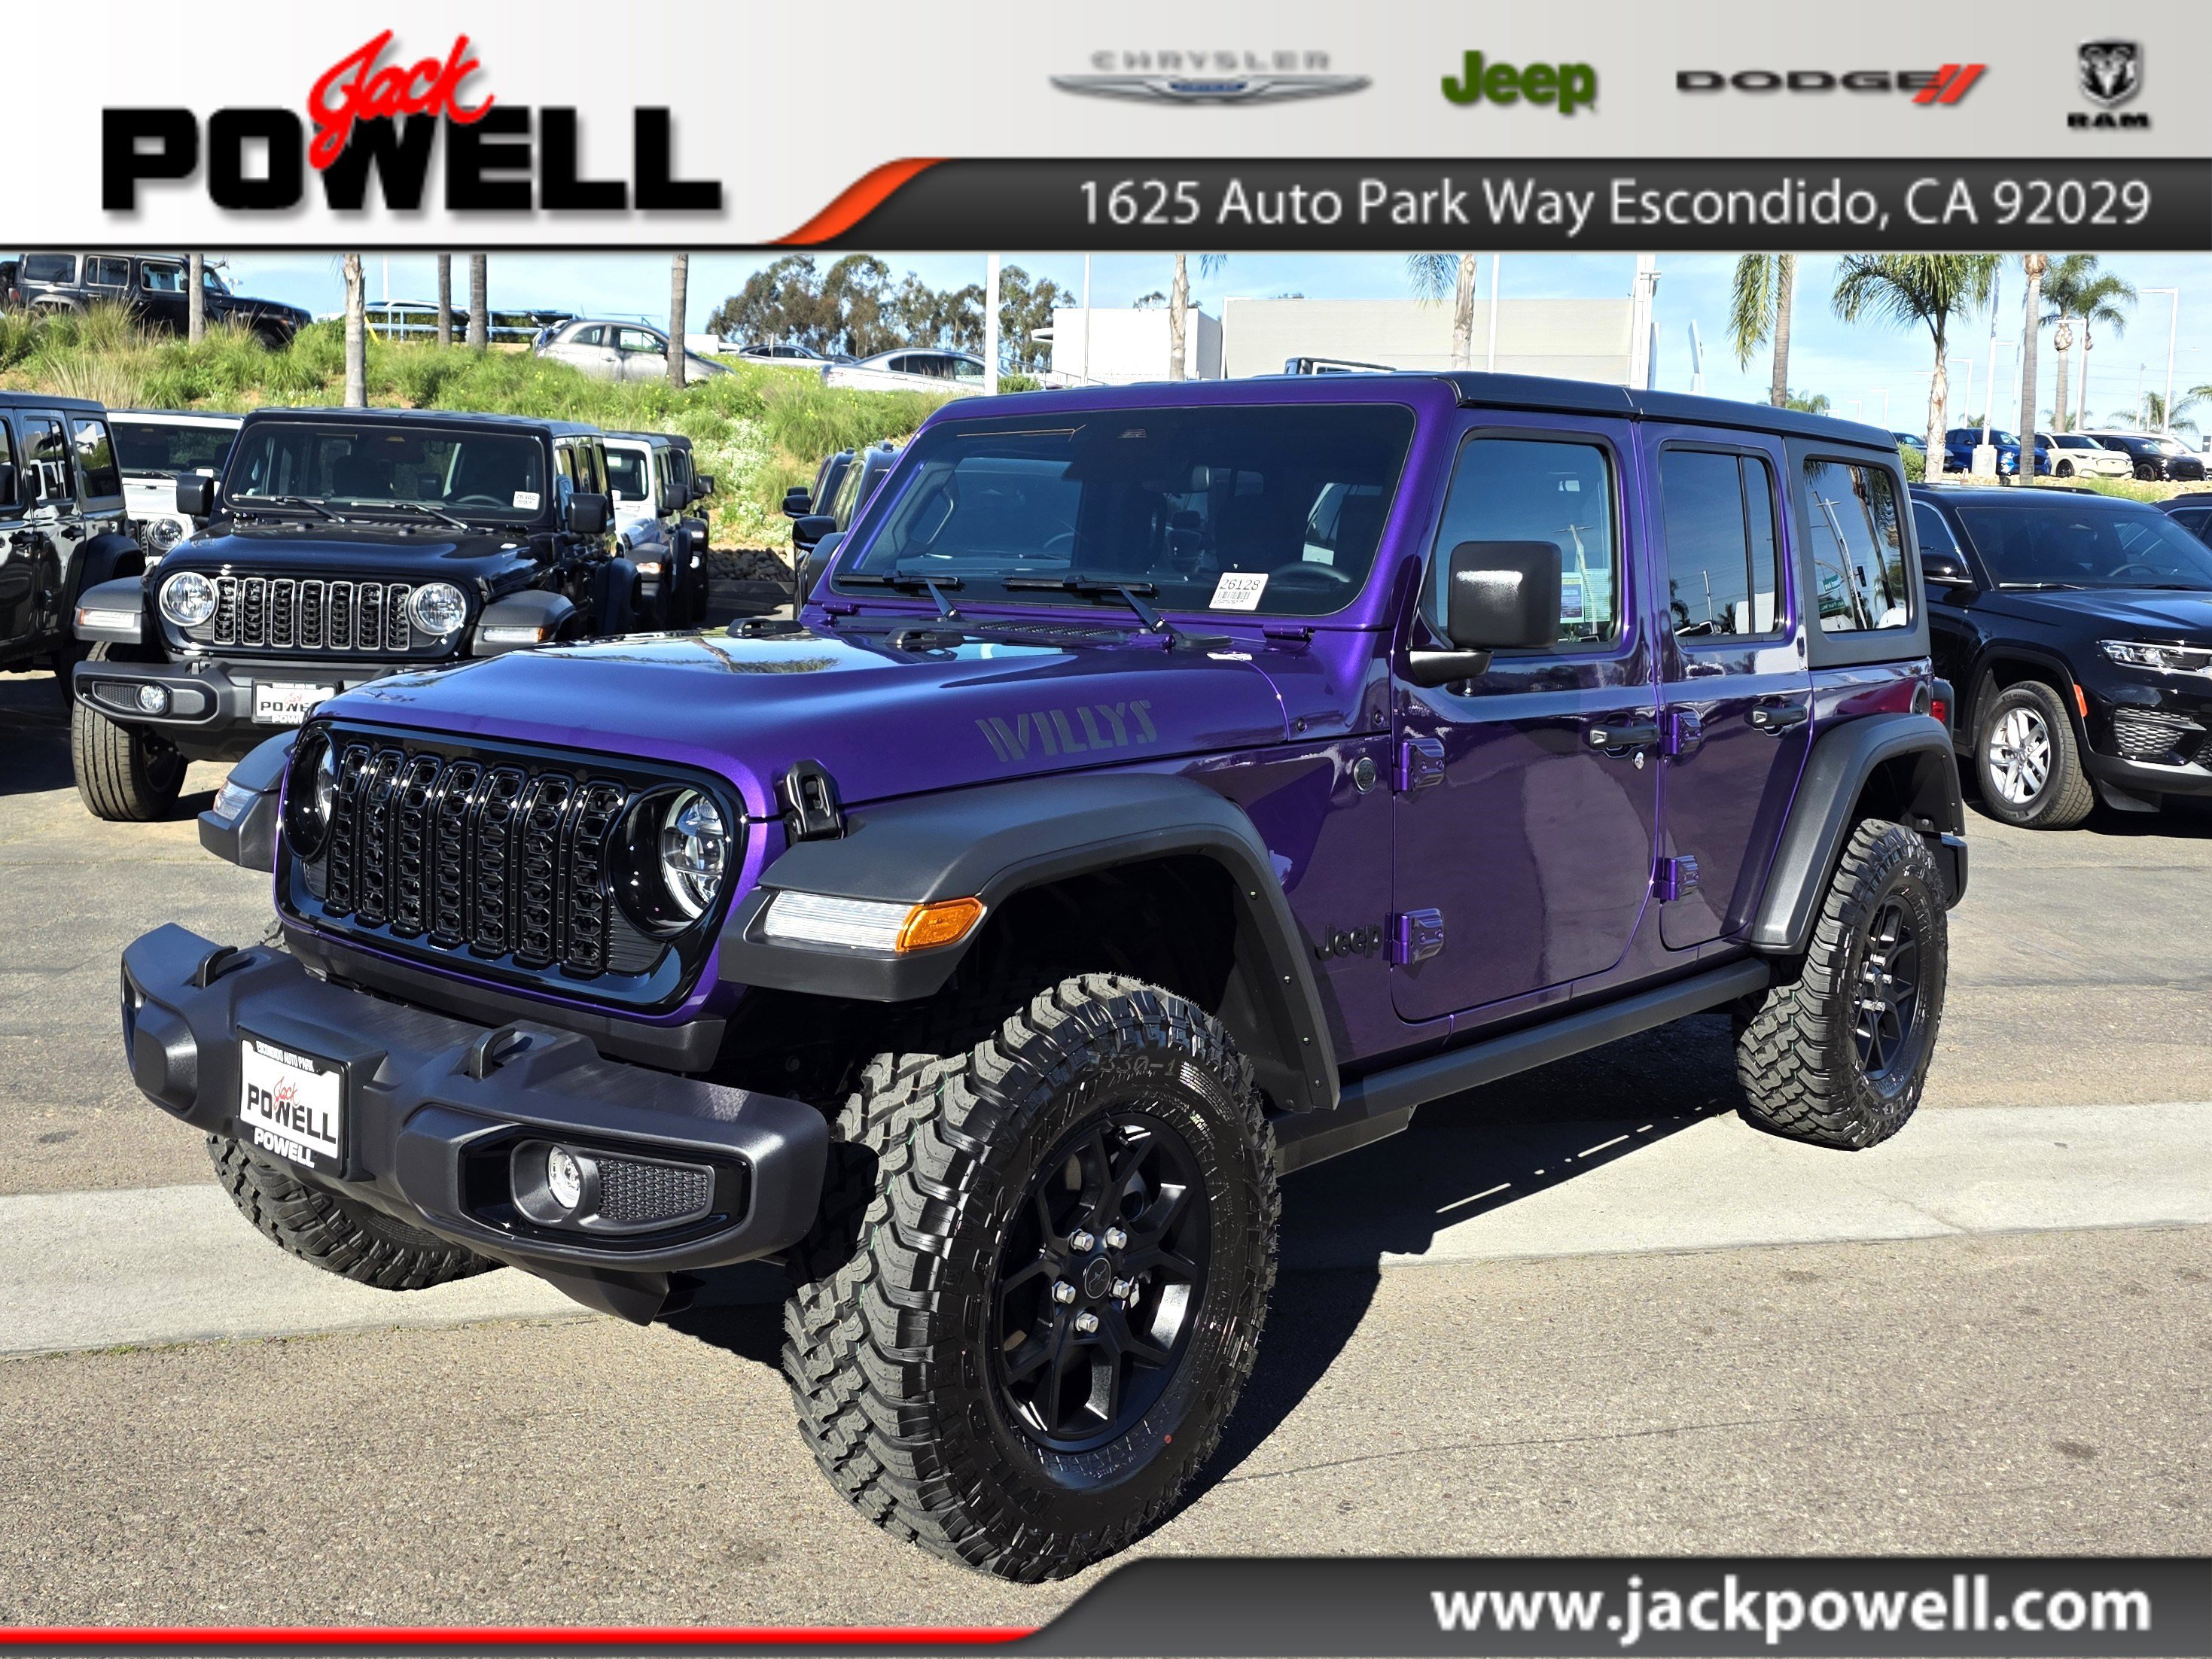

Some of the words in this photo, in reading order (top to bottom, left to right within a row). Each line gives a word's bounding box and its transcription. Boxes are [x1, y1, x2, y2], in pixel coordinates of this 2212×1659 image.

[1219, 579, 1261, 591] 26128
[975, 700, 1157, 763] WILLYS
[1315, 924, 1383, 961] Jeep
[273, 1076, 300, 1110] Jack
[247, 1083, 337, 1145] POWELL
[254, 1128, 315, 1168] POWELL
